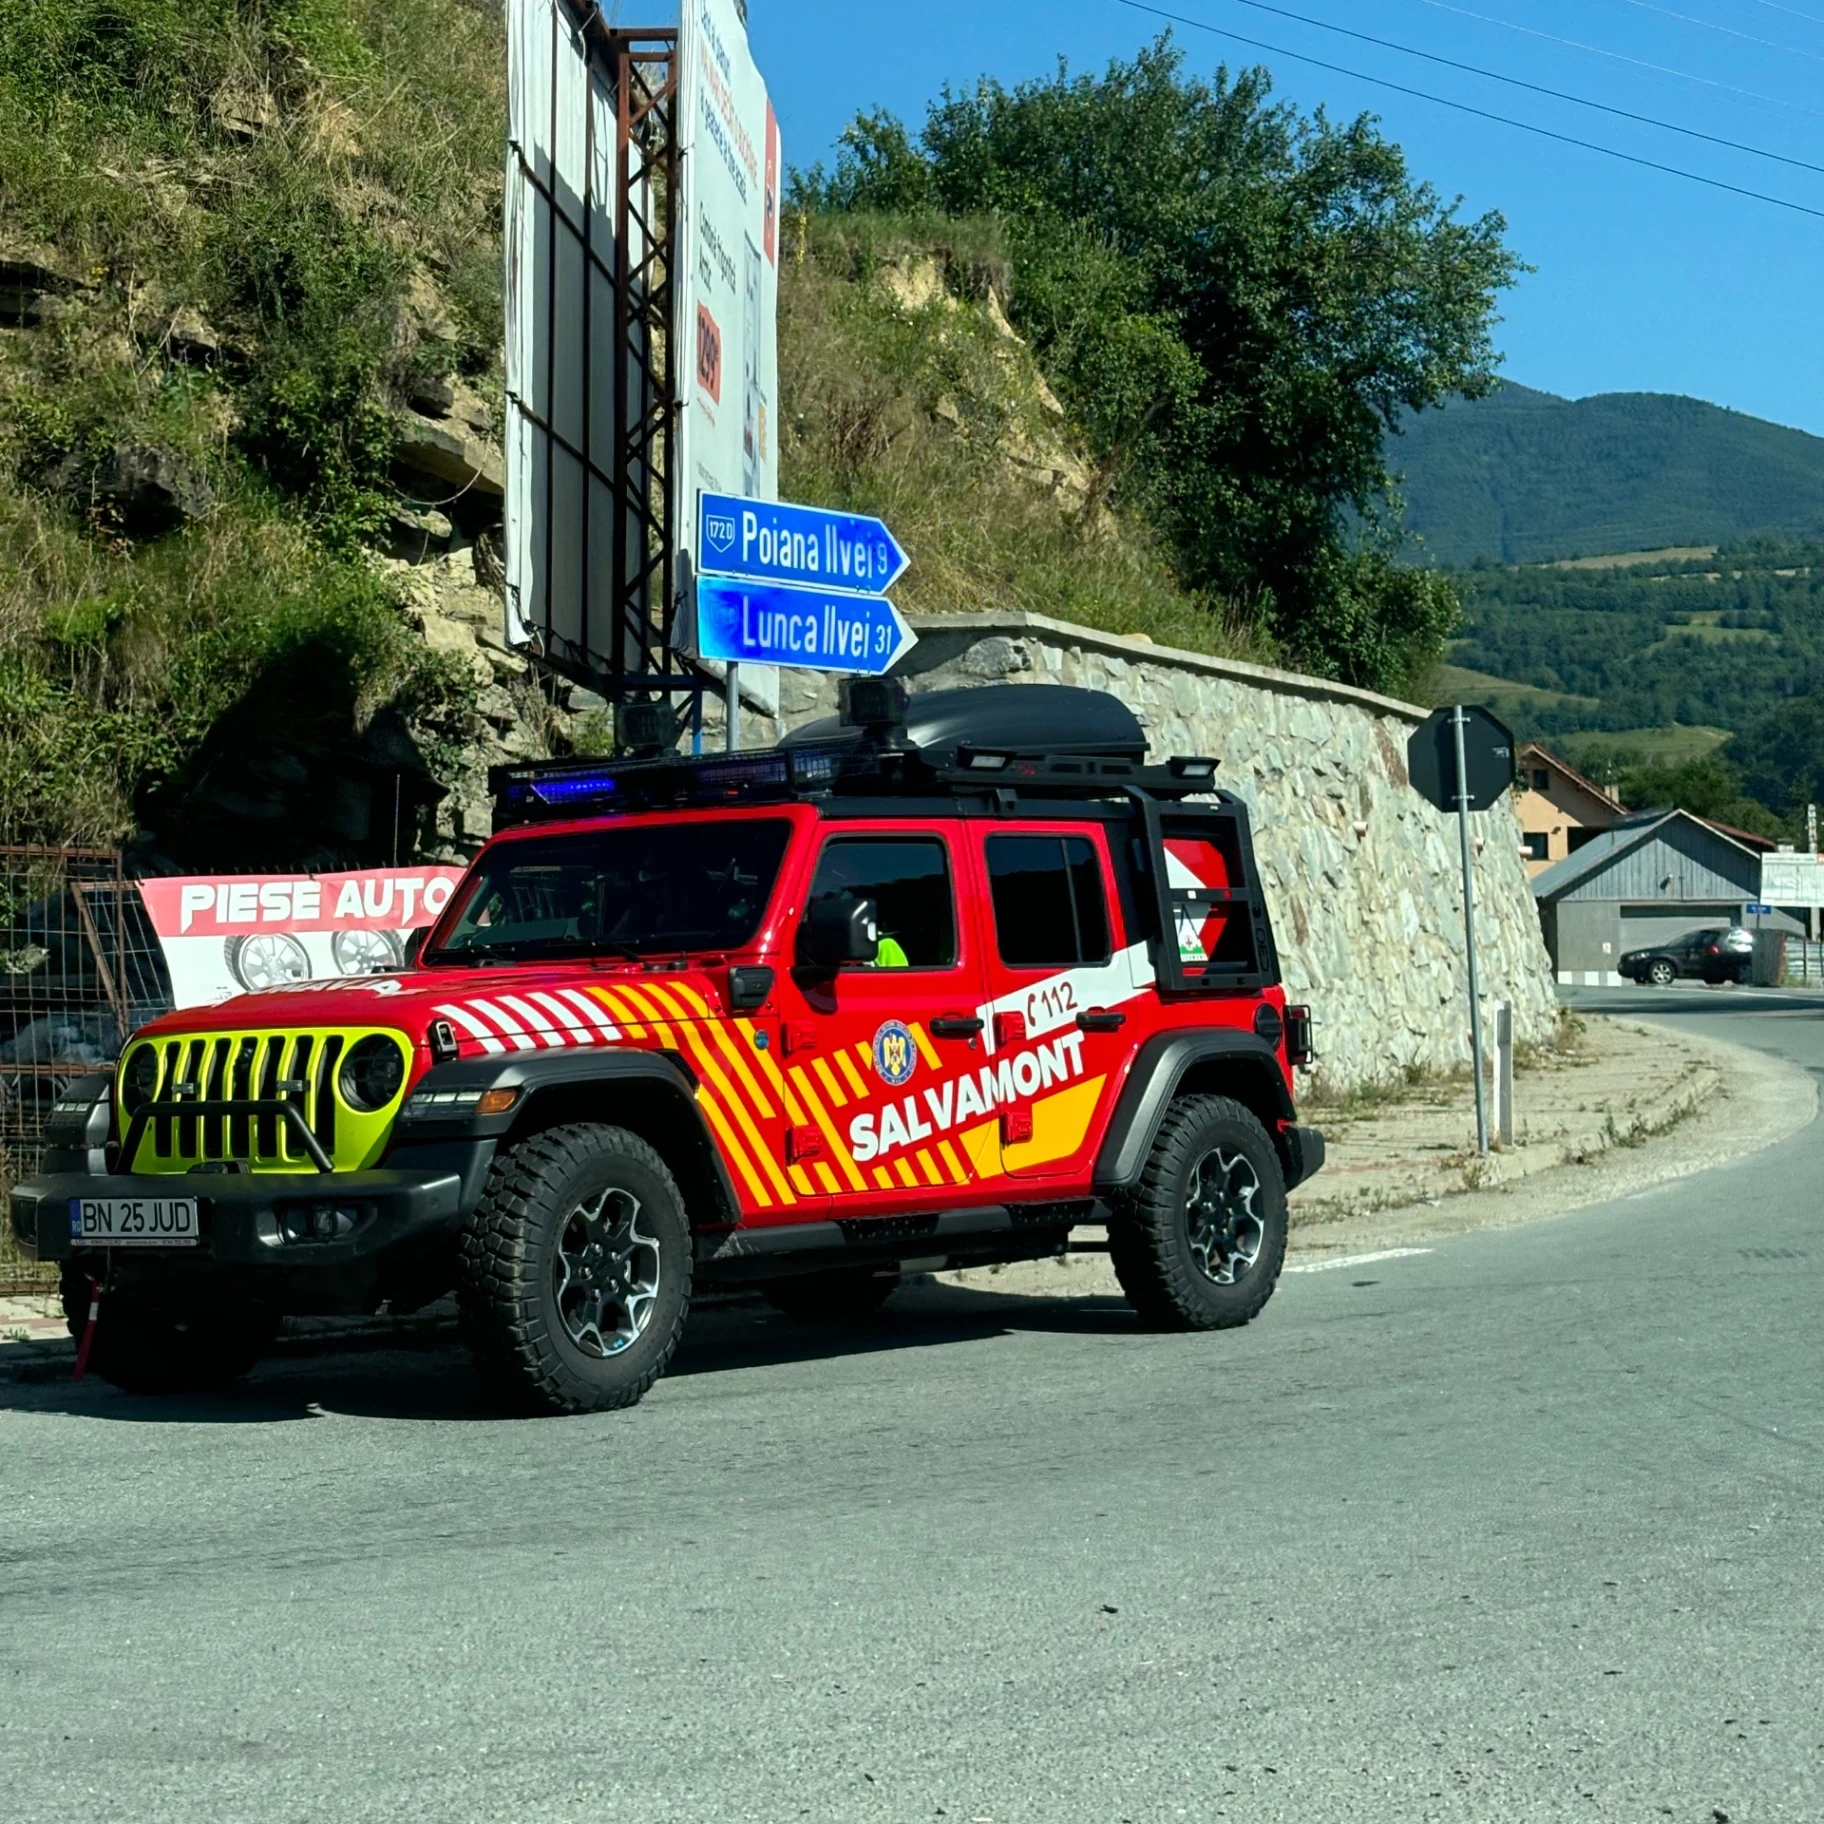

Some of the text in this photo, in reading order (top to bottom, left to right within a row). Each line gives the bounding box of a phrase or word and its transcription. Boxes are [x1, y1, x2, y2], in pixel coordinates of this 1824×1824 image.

[743, 510, 888, 579] Poiana Ilvei 9
[743, 595, 892, 658] Lunca Ilvei 31
[179, 876, 456, 935] PIESE AUTO
[1041, 981, 1078, 1019] 112
[849, 1030, 1085, 1162] SALVAMONT
[82, 1201, 191, 1233] BN 25 JUD
